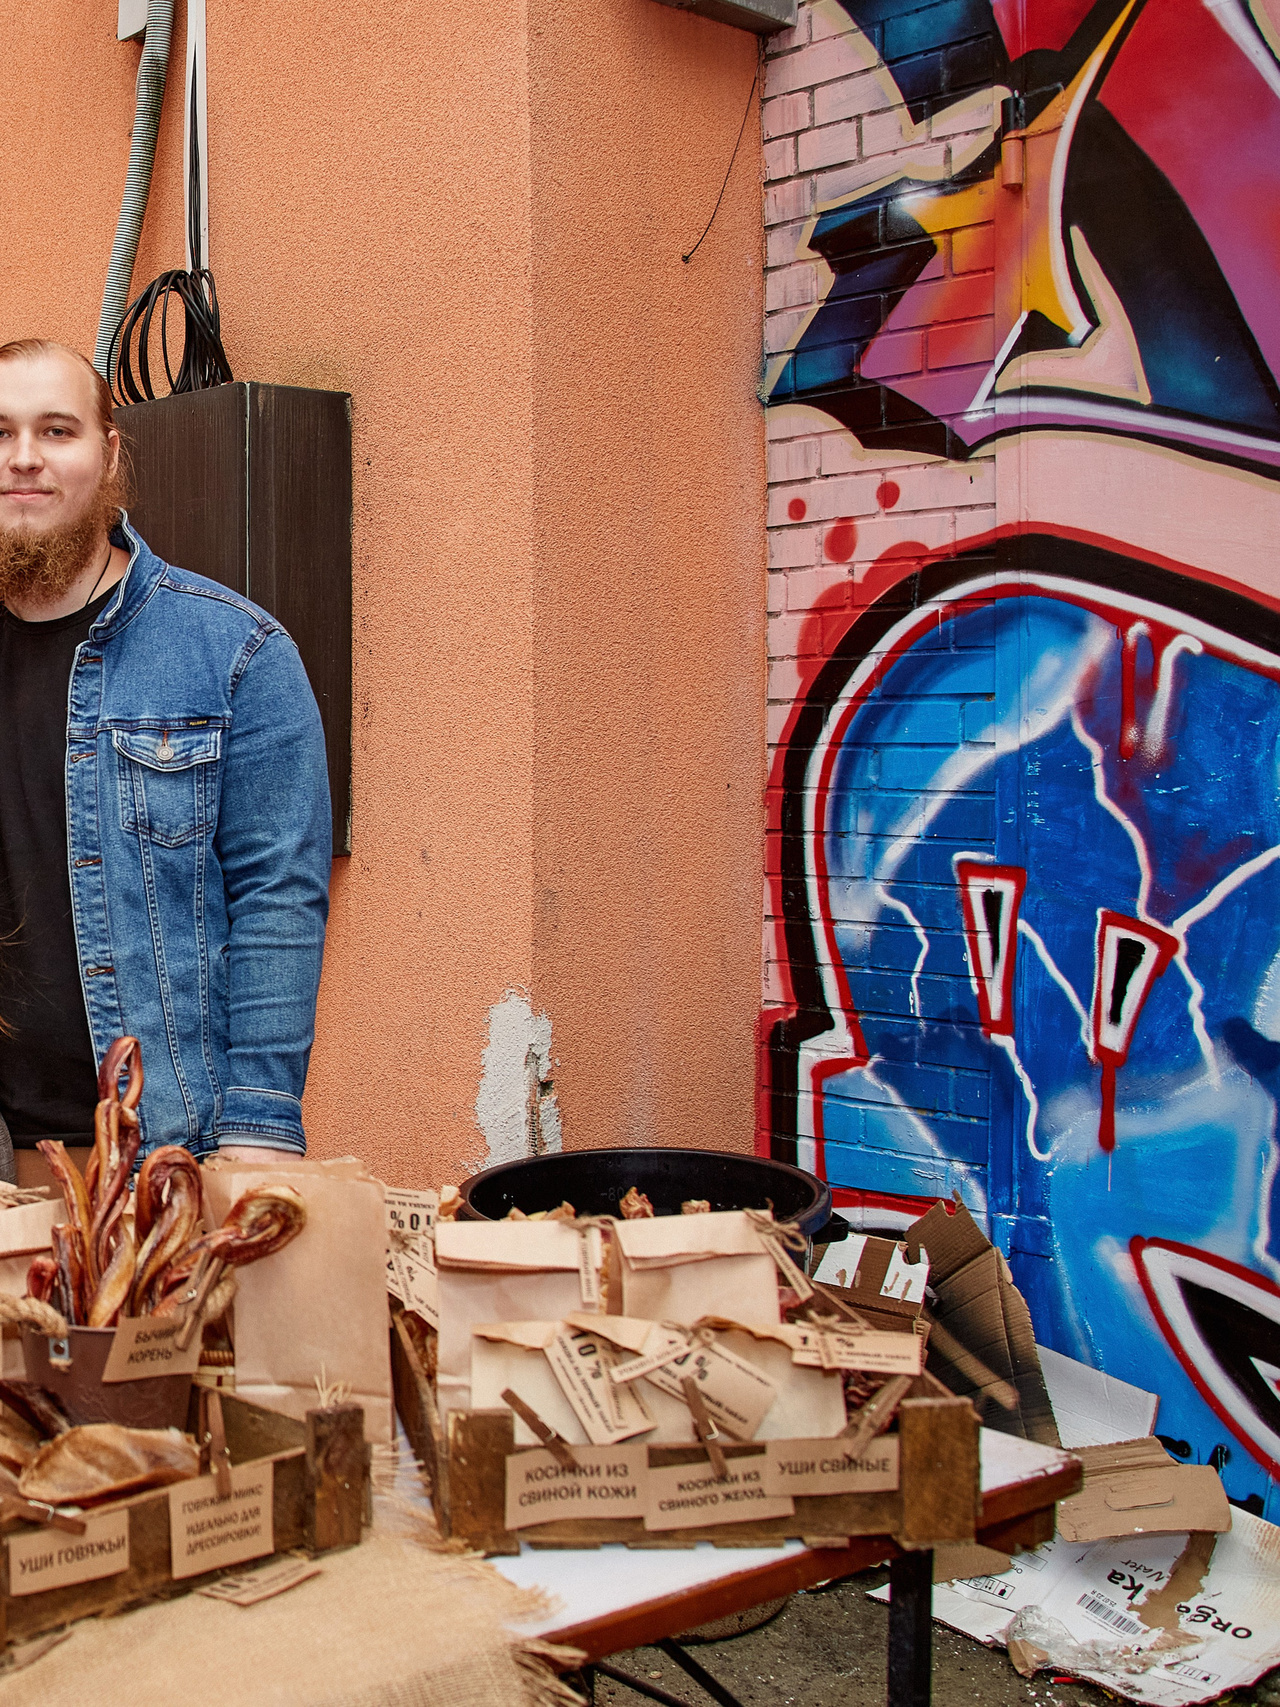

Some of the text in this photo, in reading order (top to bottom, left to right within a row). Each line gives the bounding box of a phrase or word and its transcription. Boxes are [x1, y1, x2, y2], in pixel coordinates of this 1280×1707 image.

[127, 1348, 173, 1364] КОРЕНЬ
[525, 1463, 629, 1484] КОСИЧКИ ИЗ
[777, 1457, 891, 1476] УШИ СВИНЫЕ
[677, 1470, 761, 1493] КОСИЧКИ ИЗ
[519, 1482, 637, 1507] СВИНОЙ КОЖИ
[659, 1493, 719, 1512] СВИНОГО
[186, 1506, 261, 1536] ИДЕАЛЬНО ДЛЯ
[19, 1535, 125, 1574] УШИ ГОВЯЖЬИ
